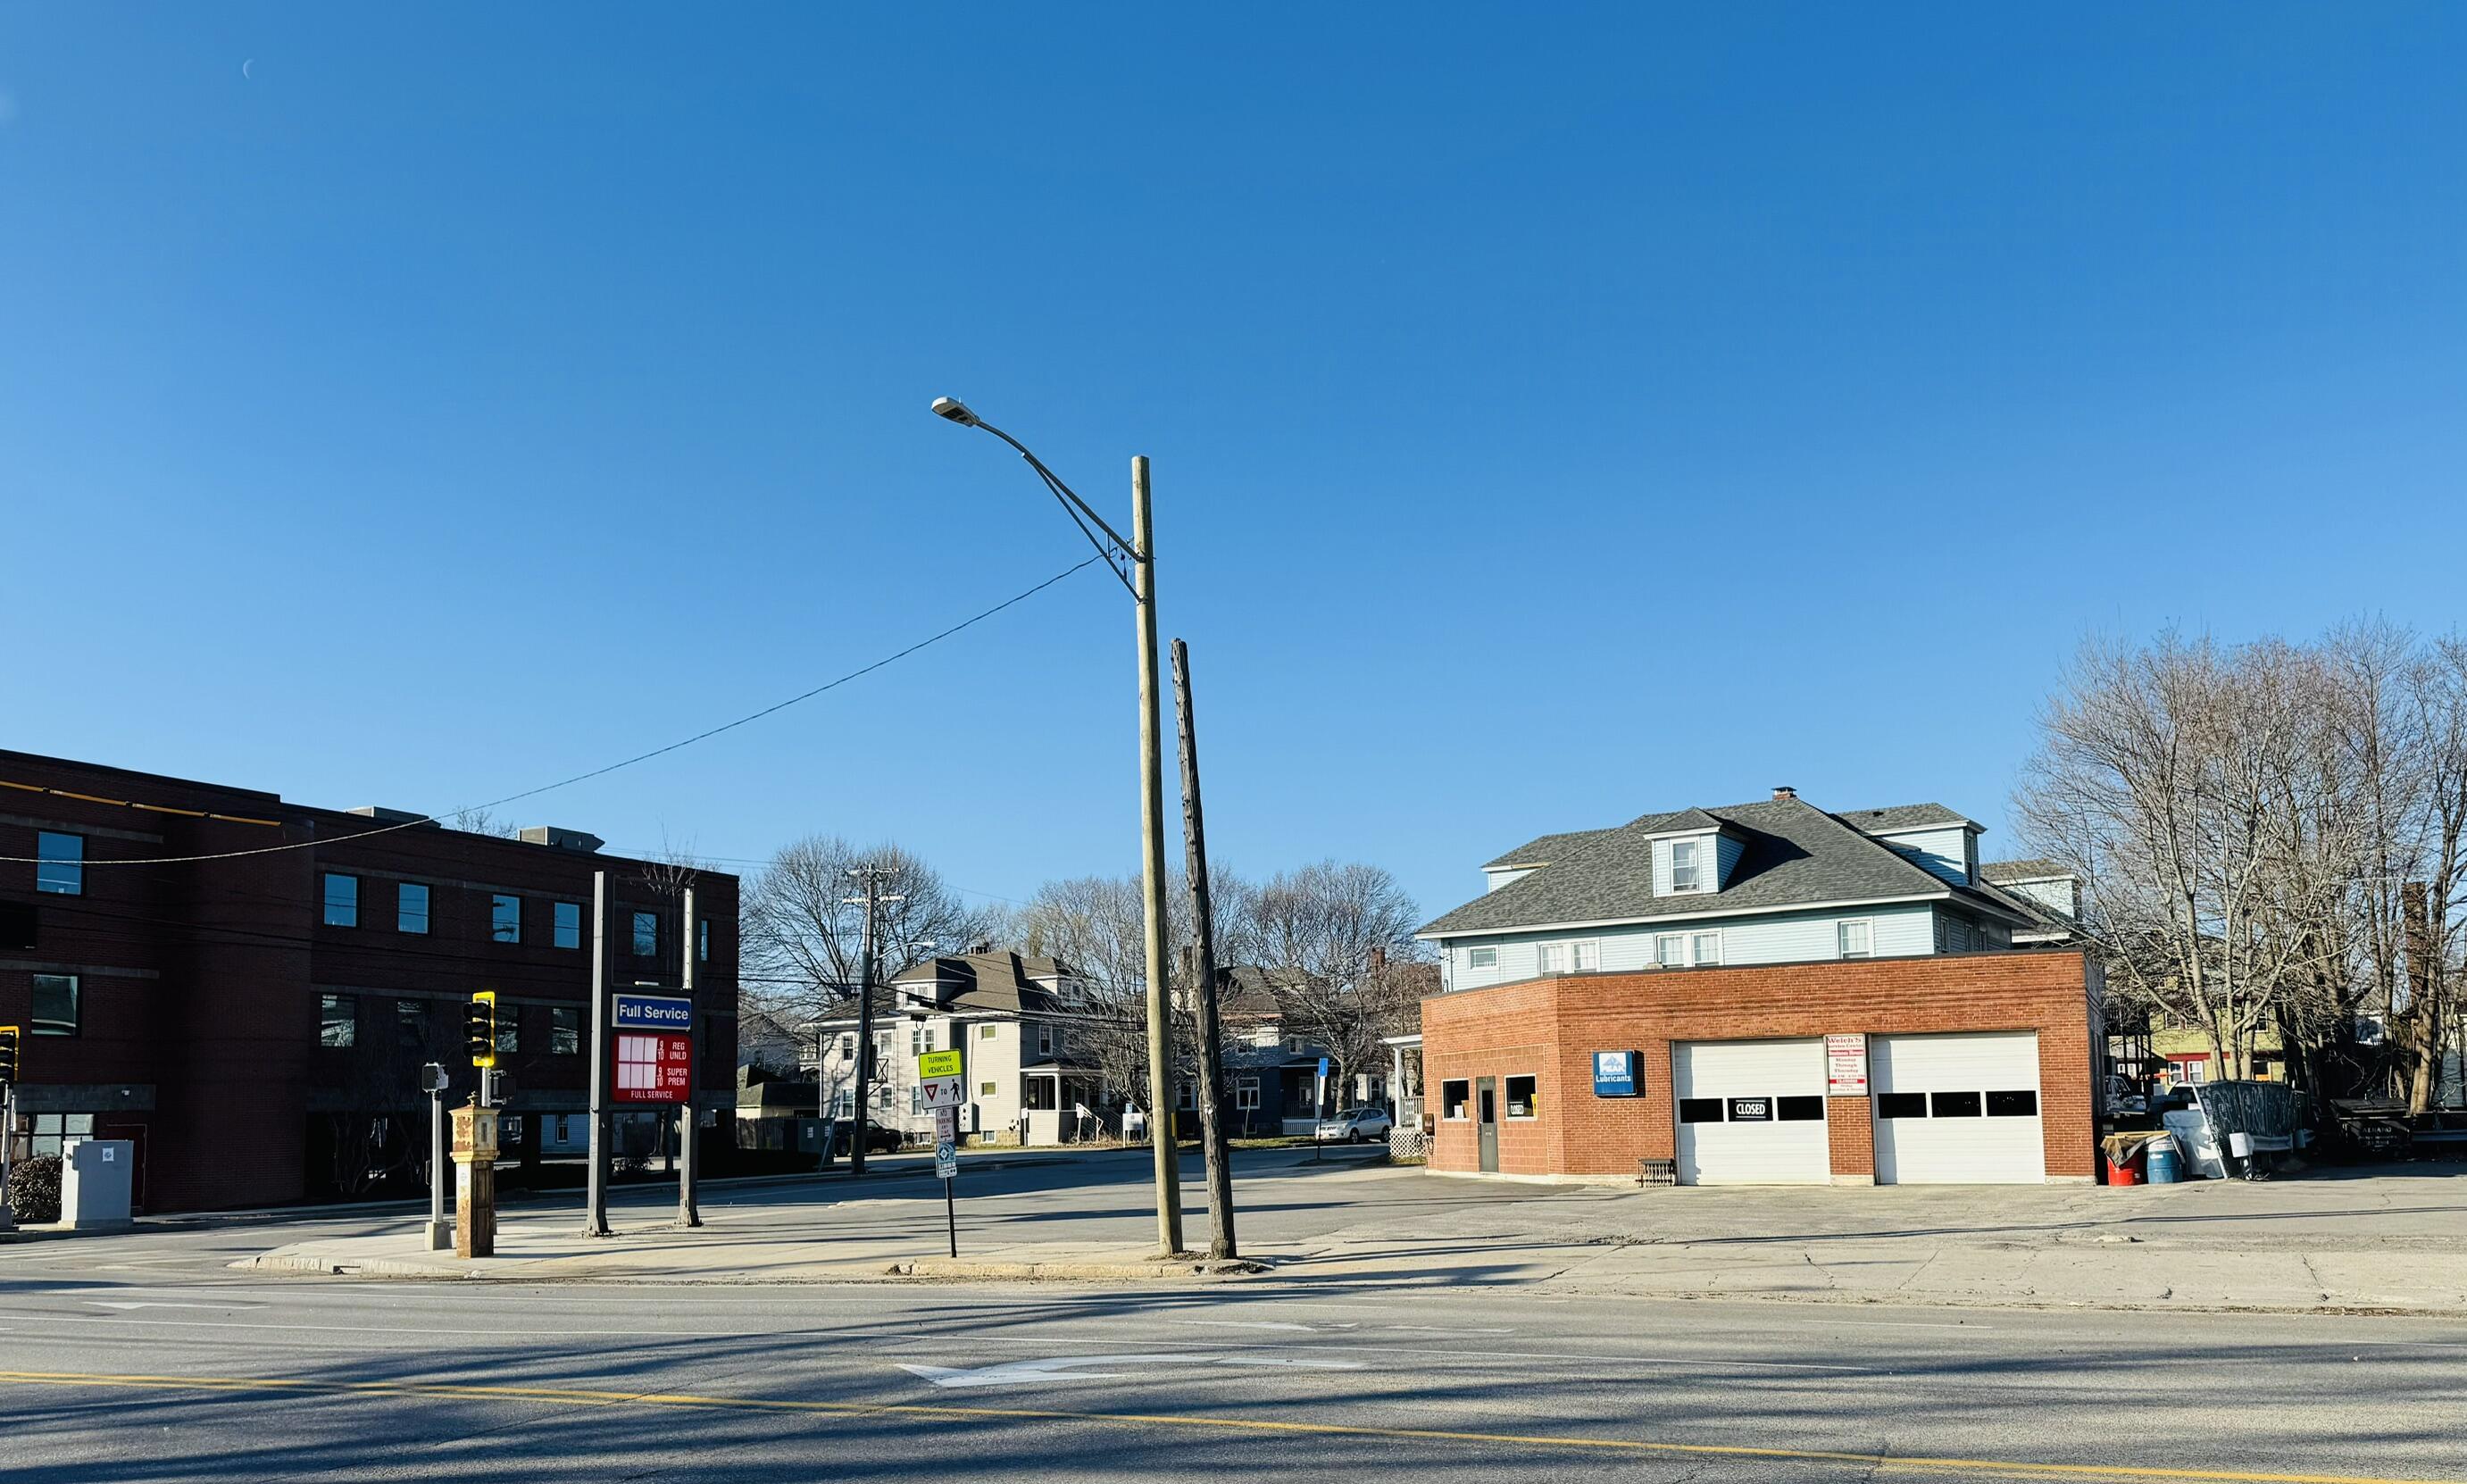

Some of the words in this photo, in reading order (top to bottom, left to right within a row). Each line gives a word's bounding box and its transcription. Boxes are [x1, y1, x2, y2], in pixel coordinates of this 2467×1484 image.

[620, 1005, 641, 1017] Full
[645, 1006, 688, 1020] Service
[659, 1040, 664, 1049] 9
[672, 1042, 685, 1050] REG
[657, 1051, 664, 1060] 10
[670, 1051, 687, 1060] UNLD
[928, 1055, 952, 1063] TURNING
[658, 1067, 663, 1076] 9
[667, 1068, 688, 1077] SUPER
[928, 1065, 953, 1073] VEHICLES
[657, 1077, 663, 1087] 10
[668, 1077, 686, 1086] PREM
[1737, 1104, 1765, 1114] CLOSED
